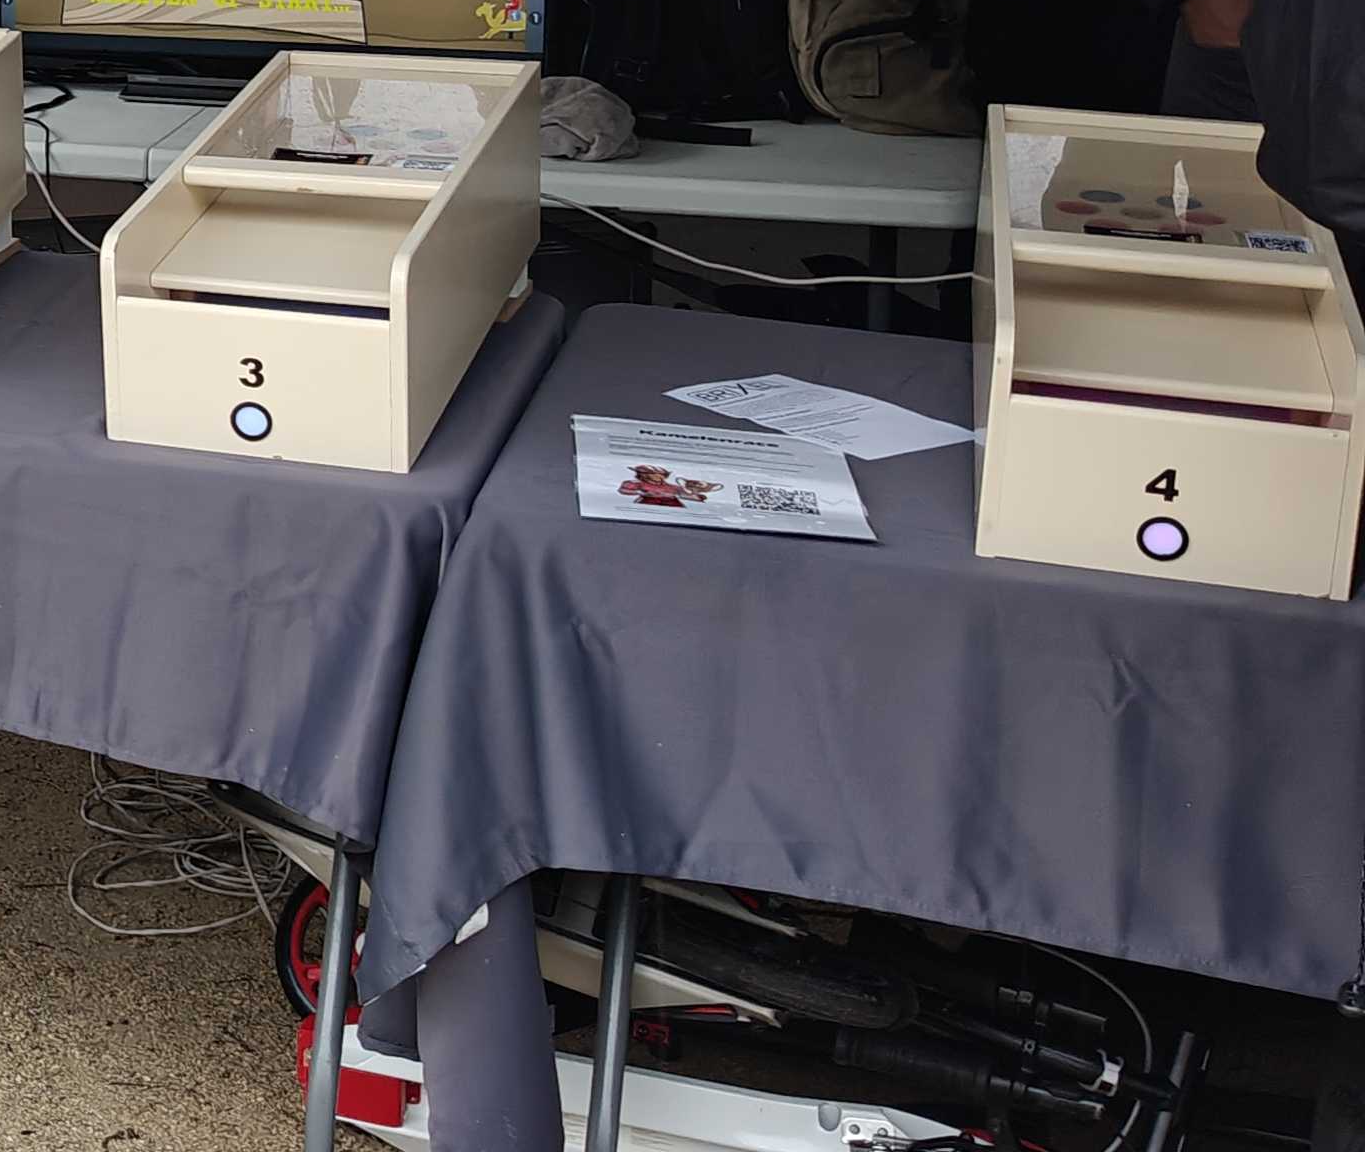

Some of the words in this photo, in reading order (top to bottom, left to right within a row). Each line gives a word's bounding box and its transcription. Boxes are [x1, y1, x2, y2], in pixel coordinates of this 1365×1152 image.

[239, 358, 265, 388] 3
[639, 429, 780, 448] Kamelenrace
[1145, 468, 1180, 503] 4
